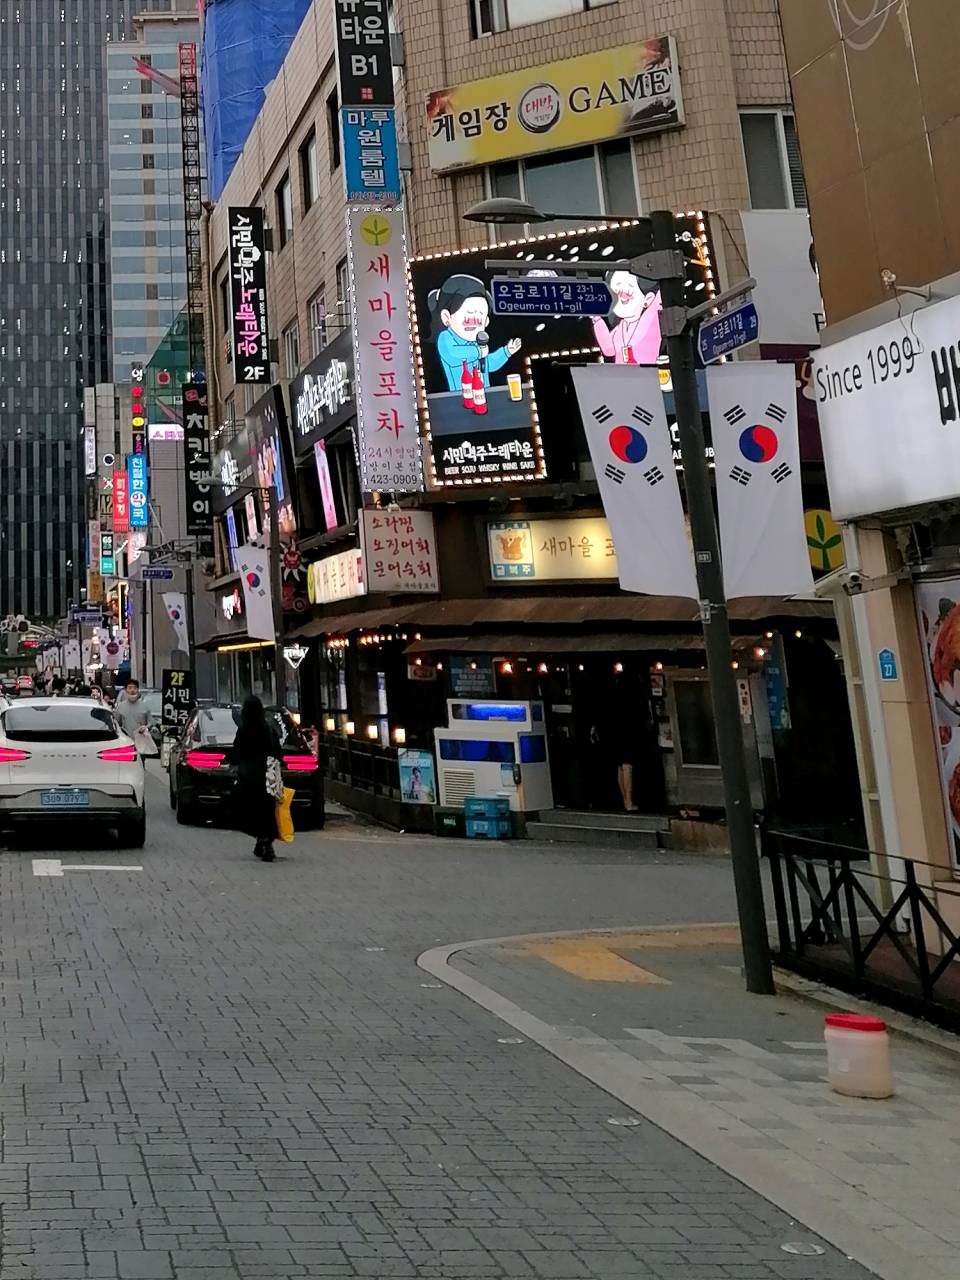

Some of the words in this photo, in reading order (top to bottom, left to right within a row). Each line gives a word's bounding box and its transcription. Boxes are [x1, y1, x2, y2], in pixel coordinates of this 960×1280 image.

[341, 16, 385, 46] 타운
[351, 53, 378, 77] B1
[431, 102, 511, 143] 게임장
[568, 69, 672, 113] GAME
[347, 111, 390, 127] 마루
[358, 129, 386, 187] 원룸텔
[498, 284, 573, 299] 오금로11길
[576, 284, 594, 293] 23-1
[498, 300, 551, 312] Ogeum-ro
[554, 302, 583, 313] 11-gil
[367, 253, 406, 441] 새마을포차
[243, 366, 265, 381] 2F
[816, 364, 863, 403] Since
[867, 336, 915, 385] 1999
[370, 474, 418, 485] 423-0909
[373, 537, 431, 556] 오징어회
[540, 535, 594, 558] 새마을
[171, 671, 185, 686] 2F
[165, 687, 190, 703] 시민
